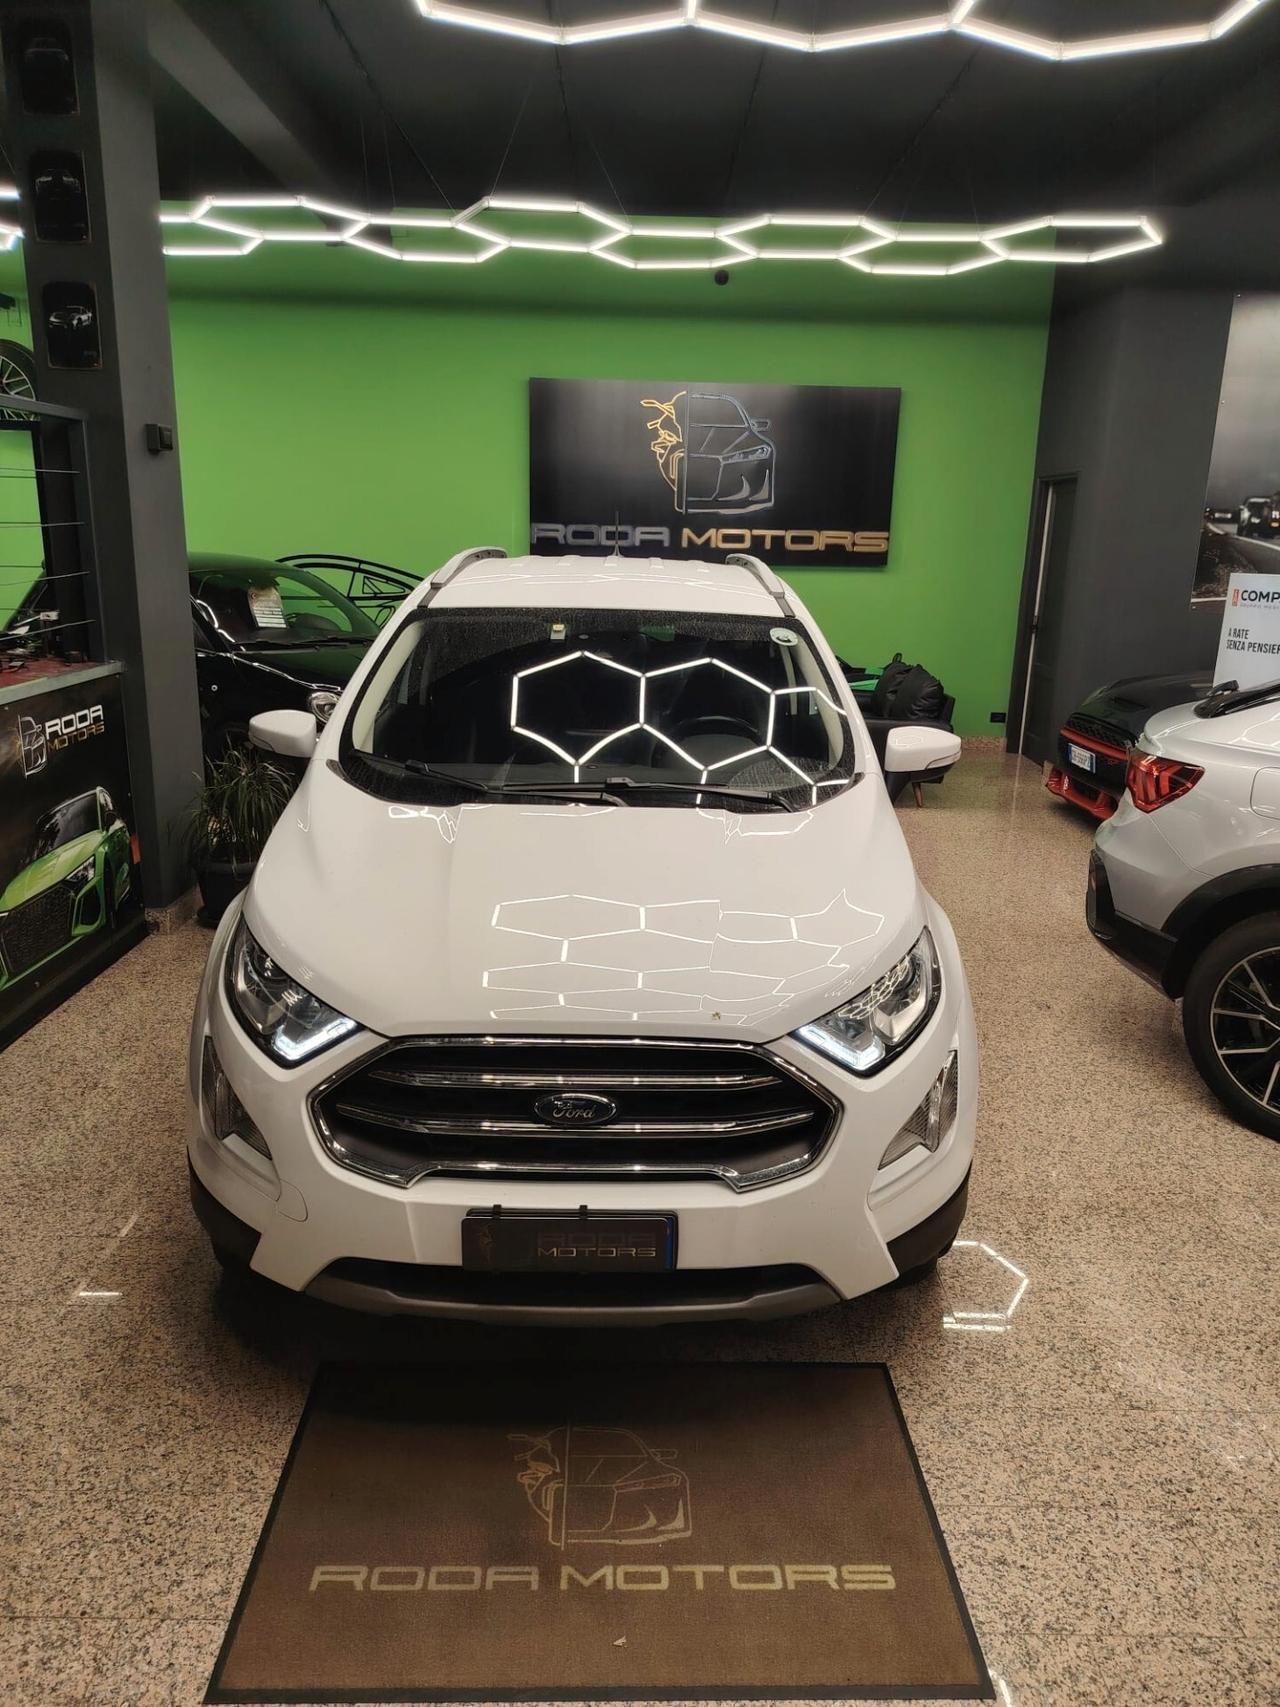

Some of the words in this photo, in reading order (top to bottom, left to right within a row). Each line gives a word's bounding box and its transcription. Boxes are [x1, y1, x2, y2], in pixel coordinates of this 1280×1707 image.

[531, 523, 669, 547] RODA
[681, 527, 889, 552] MOTORS
[1241, 590, 1280, 603] COMP
[1233, 628, 1249, 639] RATE
[1226, 640, 1245, 651] SENZA
[45, 705, 104, 740] RODA
[47, 721, 105, 752] MOTORS
[552, 1101, 596, 1119] Ford
[537, 1247, 656, 1257] MOTORS
[309, 1565, 540, 1592] RODA
[560, 1564, 896, 1591] MOTORS
